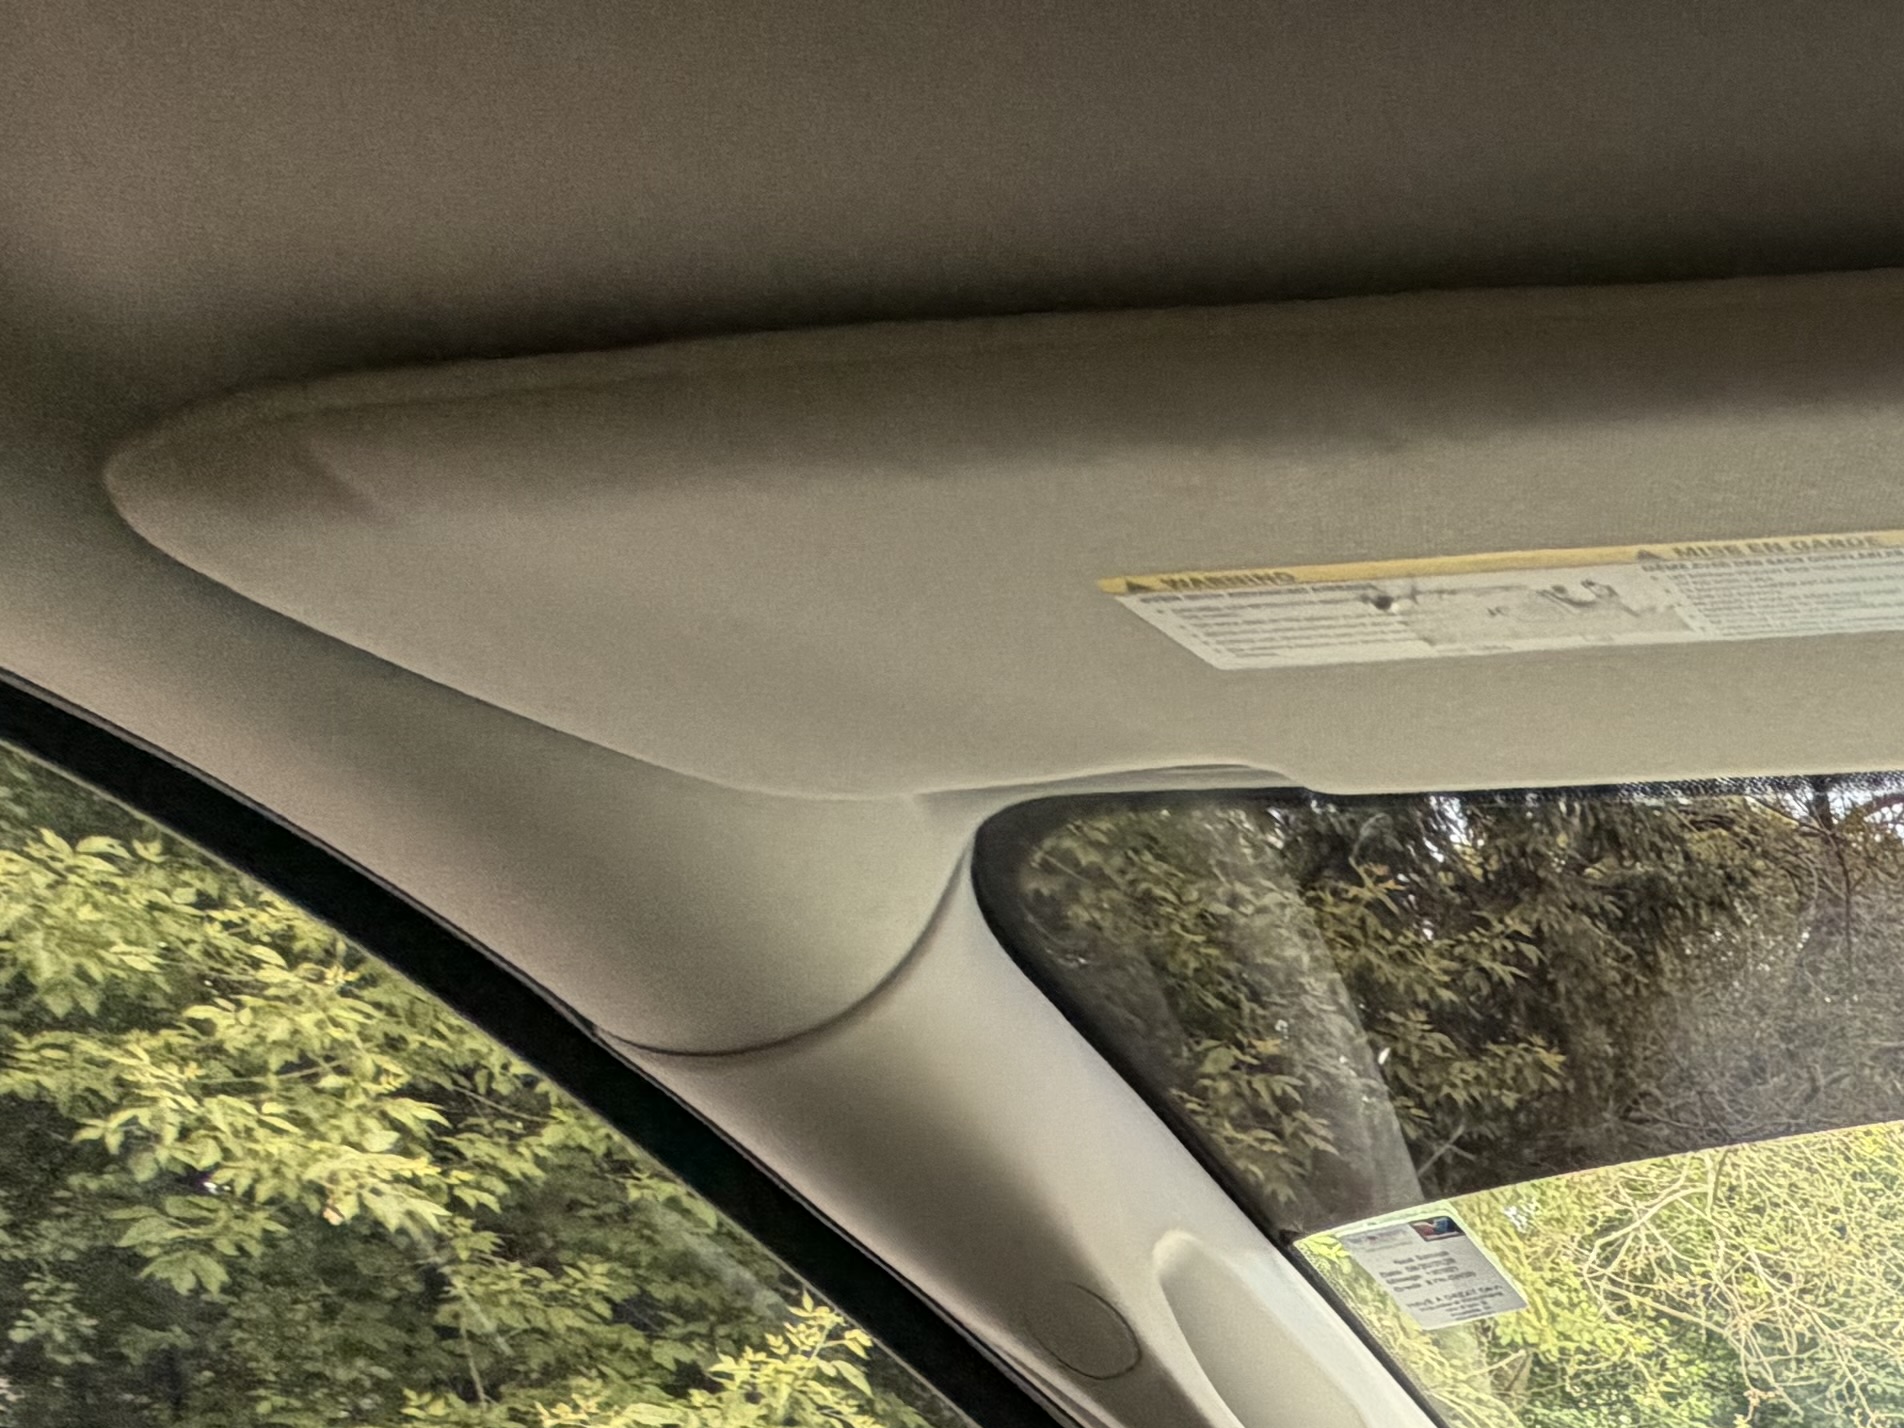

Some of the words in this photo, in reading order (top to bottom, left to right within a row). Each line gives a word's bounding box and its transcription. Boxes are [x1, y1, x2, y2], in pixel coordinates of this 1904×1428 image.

[1673, 545, 1745, 559] MISE
[1746, 542, 1785, 553] EN
[1790, 536, 1878, 550] GARDE
[1160, 571, 1295, 591] WARNING
